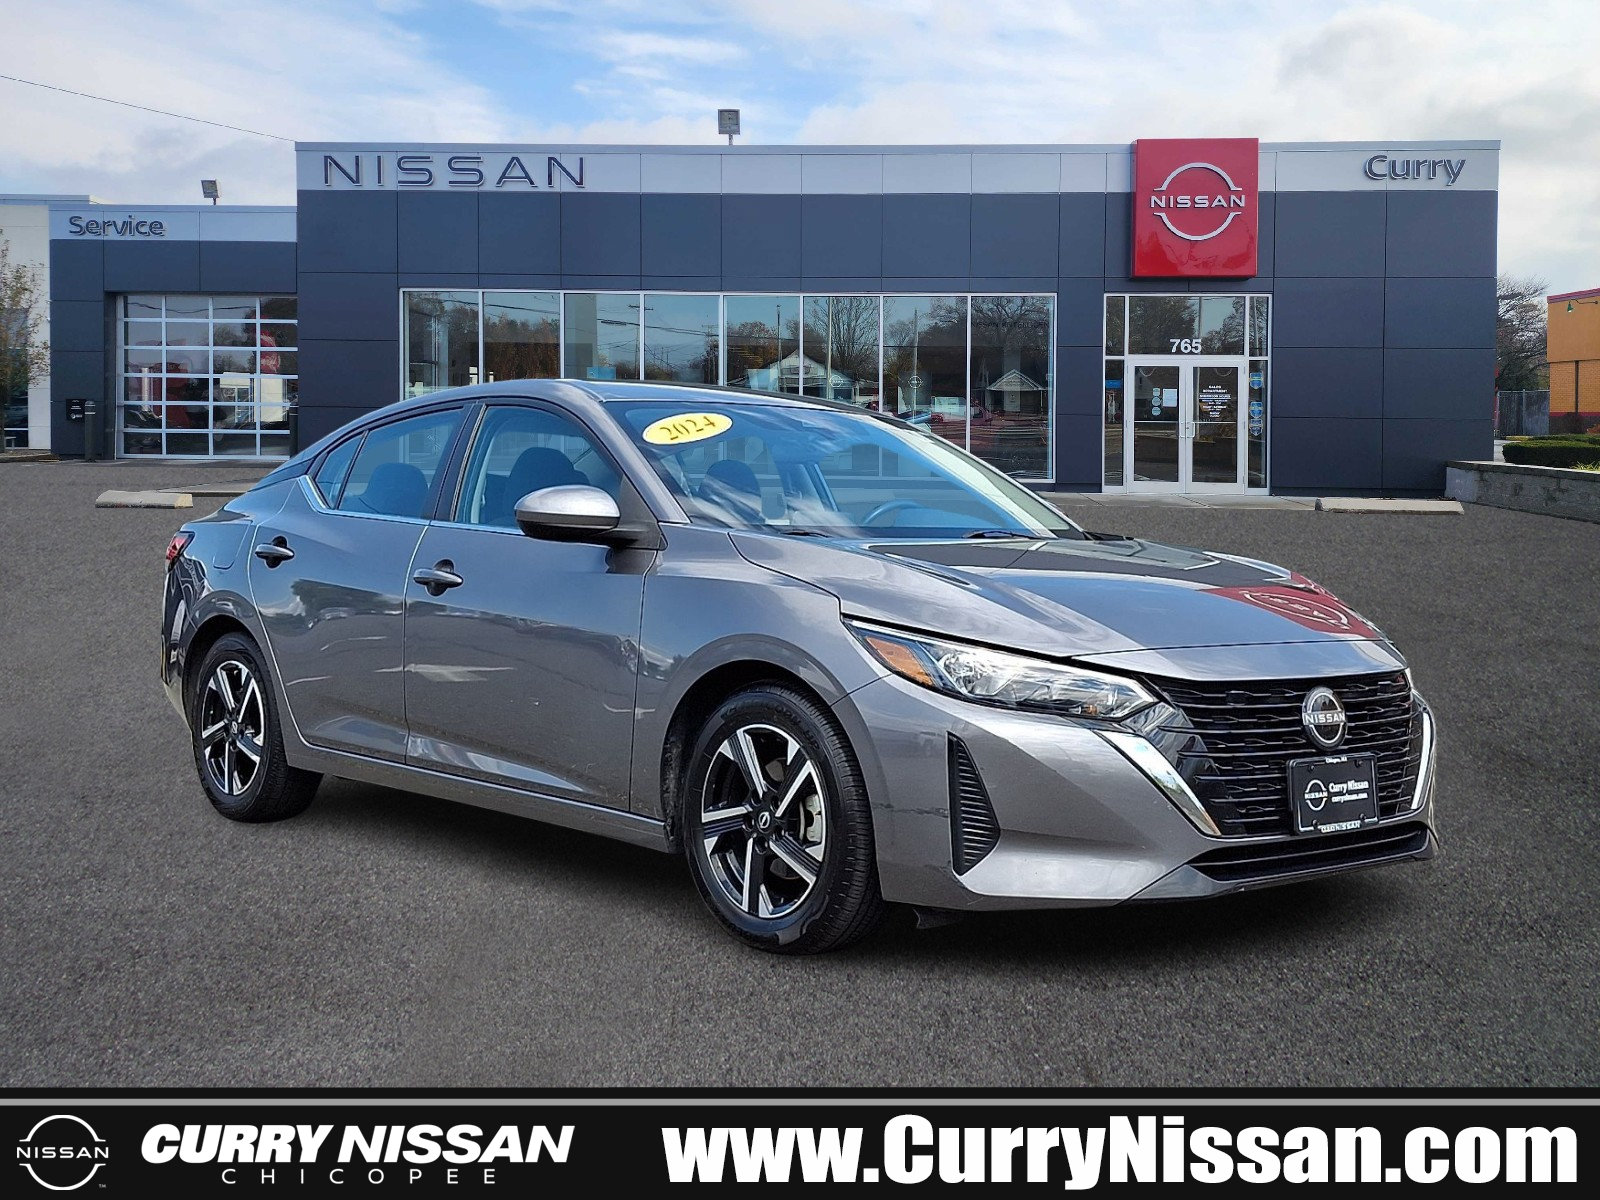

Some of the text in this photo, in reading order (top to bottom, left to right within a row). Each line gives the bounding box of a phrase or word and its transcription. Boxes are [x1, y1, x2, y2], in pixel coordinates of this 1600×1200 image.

[323, 154, 585, 187] NISSAN
[1364, 154, 1466, 185] Curry
[1150, 194, 1246, 208] NISSAN
[68, 215, 166, 237] Service
[1169, 338, 1203, 354] 765
[659, 415, 716, 440] 2024
[1304, 712, 1346, 724] NISSAN
[1328, 782, 1348, 794] Curry
